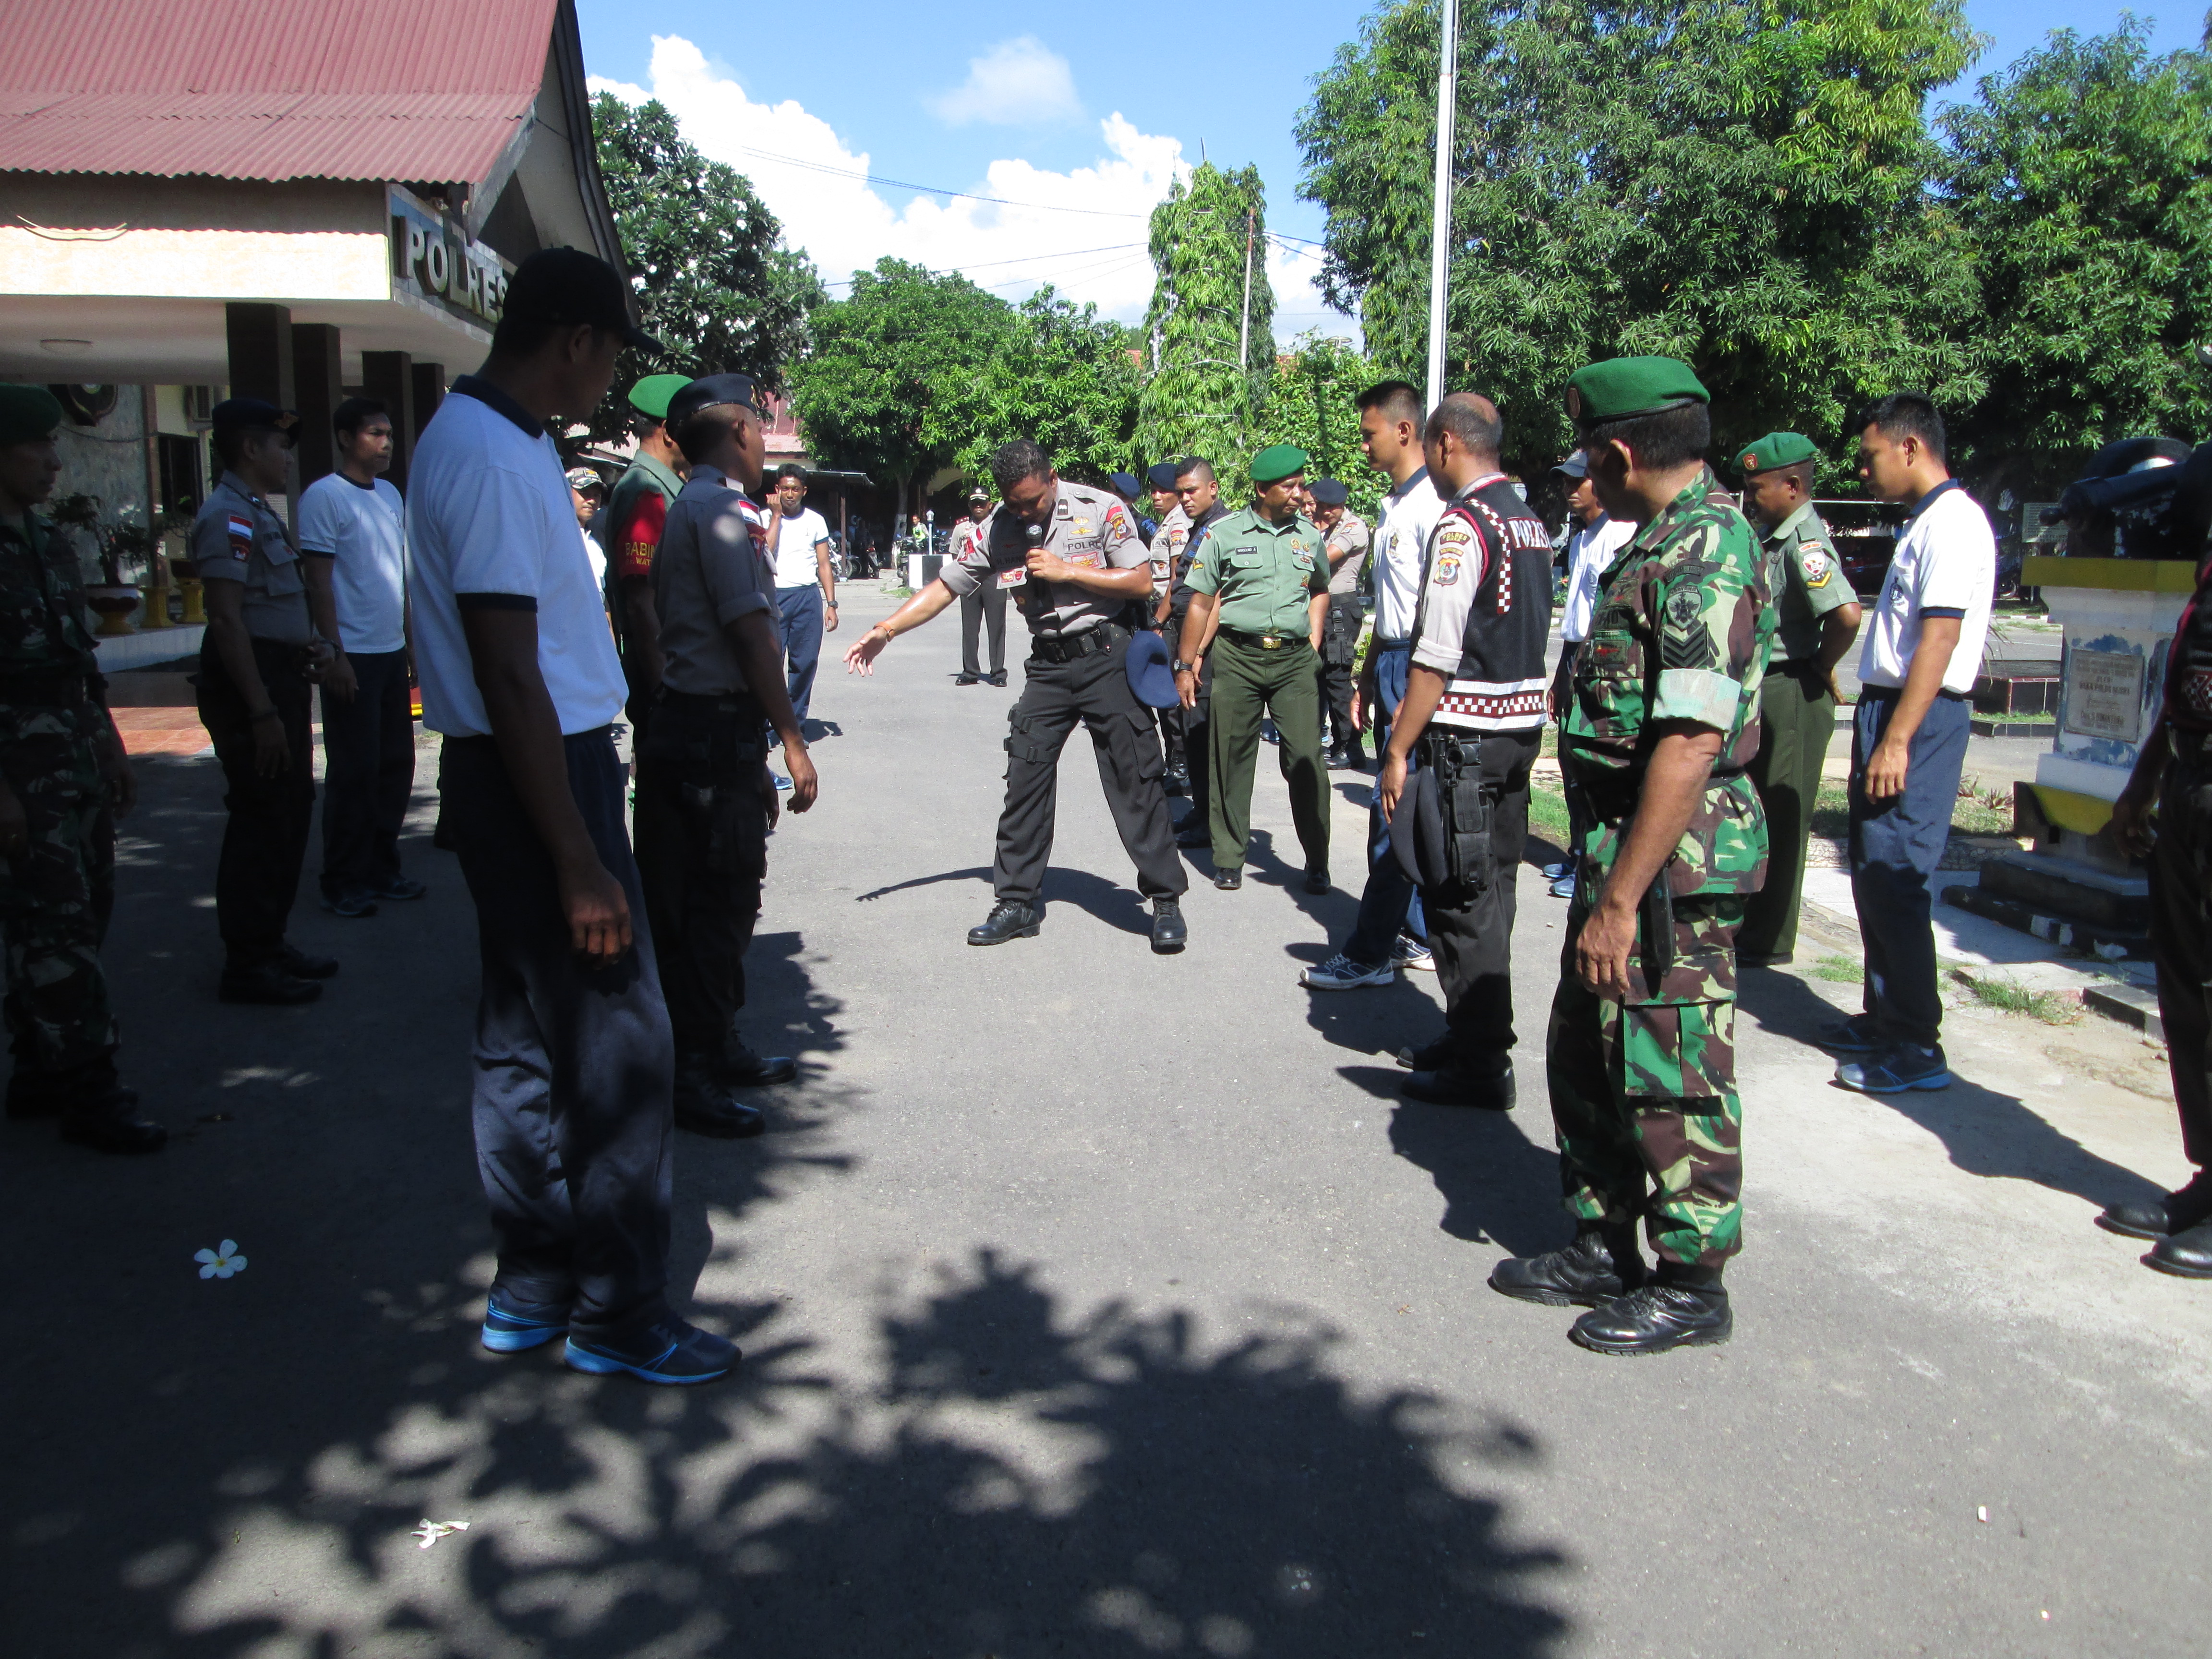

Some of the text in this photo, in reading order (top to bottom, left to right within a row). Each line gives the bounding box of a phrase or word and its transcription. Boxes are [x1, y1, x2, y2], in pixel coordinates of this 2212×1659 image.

[397, 216, 509, 324] POLRES
[1442, 532, 1468, 541] POLRES
[1508, 519, 1551, 549] POLISI
